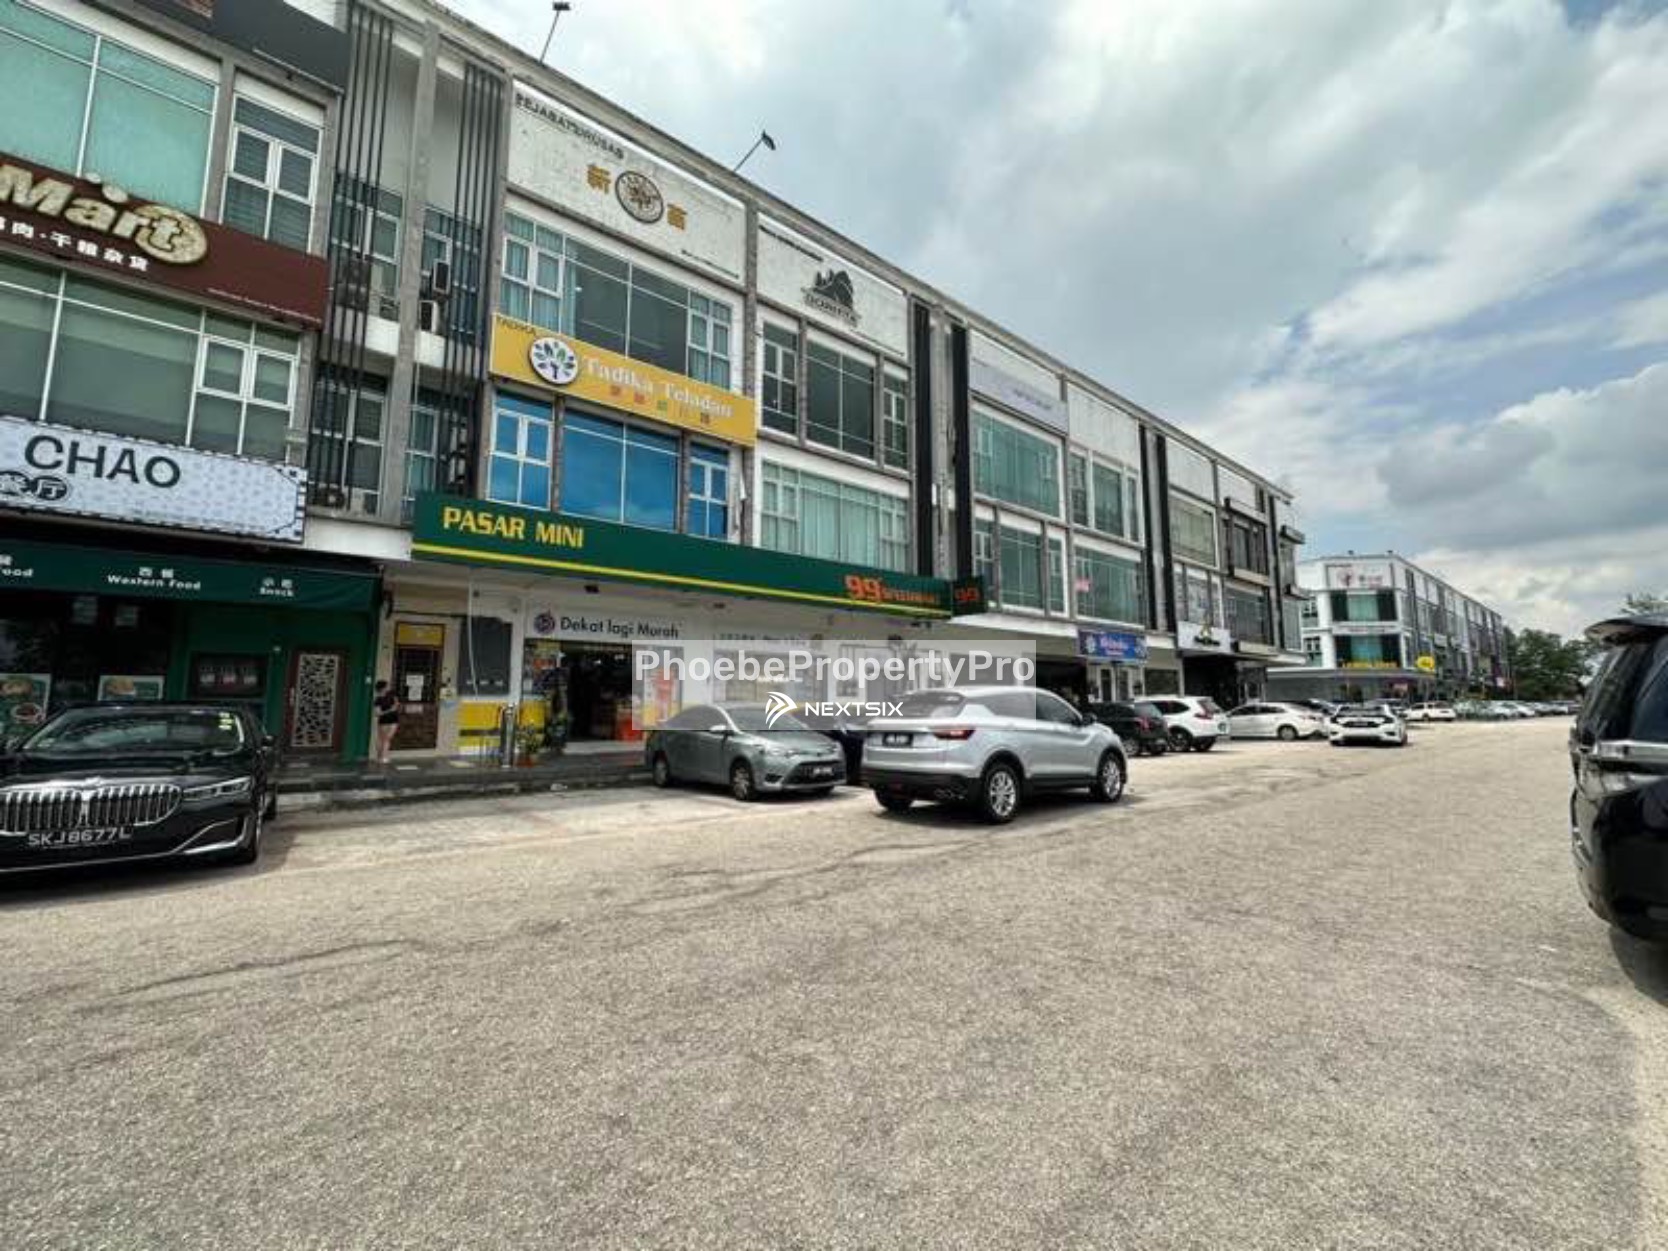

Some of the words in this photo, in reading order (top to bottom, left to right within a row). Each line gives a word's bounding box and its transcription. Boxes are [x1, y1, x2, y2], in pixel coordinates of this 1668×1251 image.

[0, 163, 182, 251] Mart
[24, 435, 181, 488] CHAO
[443, 506, 525, 540] PASAR
[535, 521, 584, 548] MINI
[107, 574, 164, 588] Western
[169, 578, 201, 590] Food
[844, 574, 882, 603] 99
[560, 616, 603, 633] Dekat
